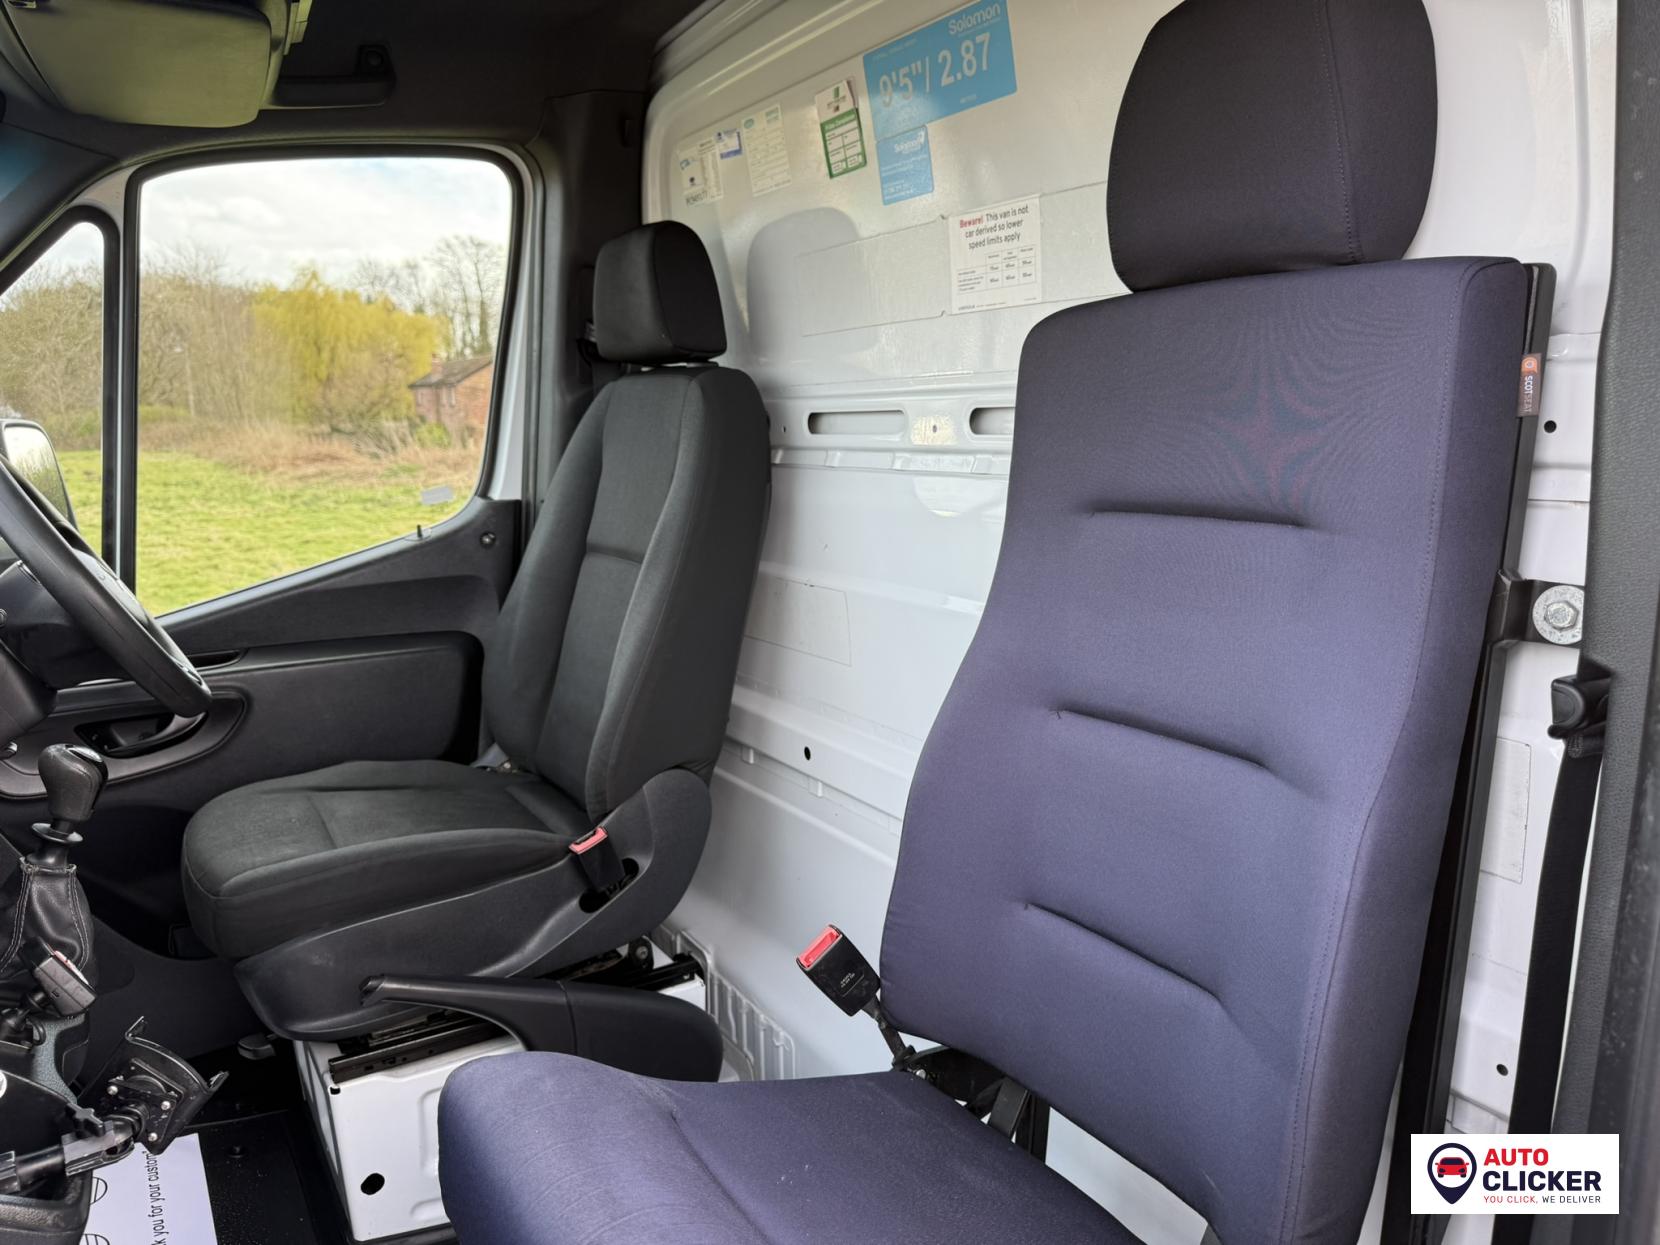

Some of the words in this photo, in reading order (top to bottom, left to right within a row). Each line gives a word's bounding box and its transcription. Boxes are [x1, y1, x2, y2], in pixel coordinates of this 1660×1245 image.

[948, 3, 1000, 35] Solomon
[960, 215, 983, 228] Beware!
[986, 213, 998, 221] This
[1000, 210, 1010, 219] van
[1012, 208, 1017, 216] is
[1018, 204, 1029, 215] not
[965, 230, 975, 238] car
[975, 223, 997, 236] derived
[1006, 219, 1023, 229] lower
[968, 238, 985, 250] speed
[987, 235, 1002, 245] limits
[1003, 232, 1021, 243] apply
[149, 1184, 165, 1202] your
[148, 1204, 163, 1218] for
[152, 1219, 169, 1237] you
